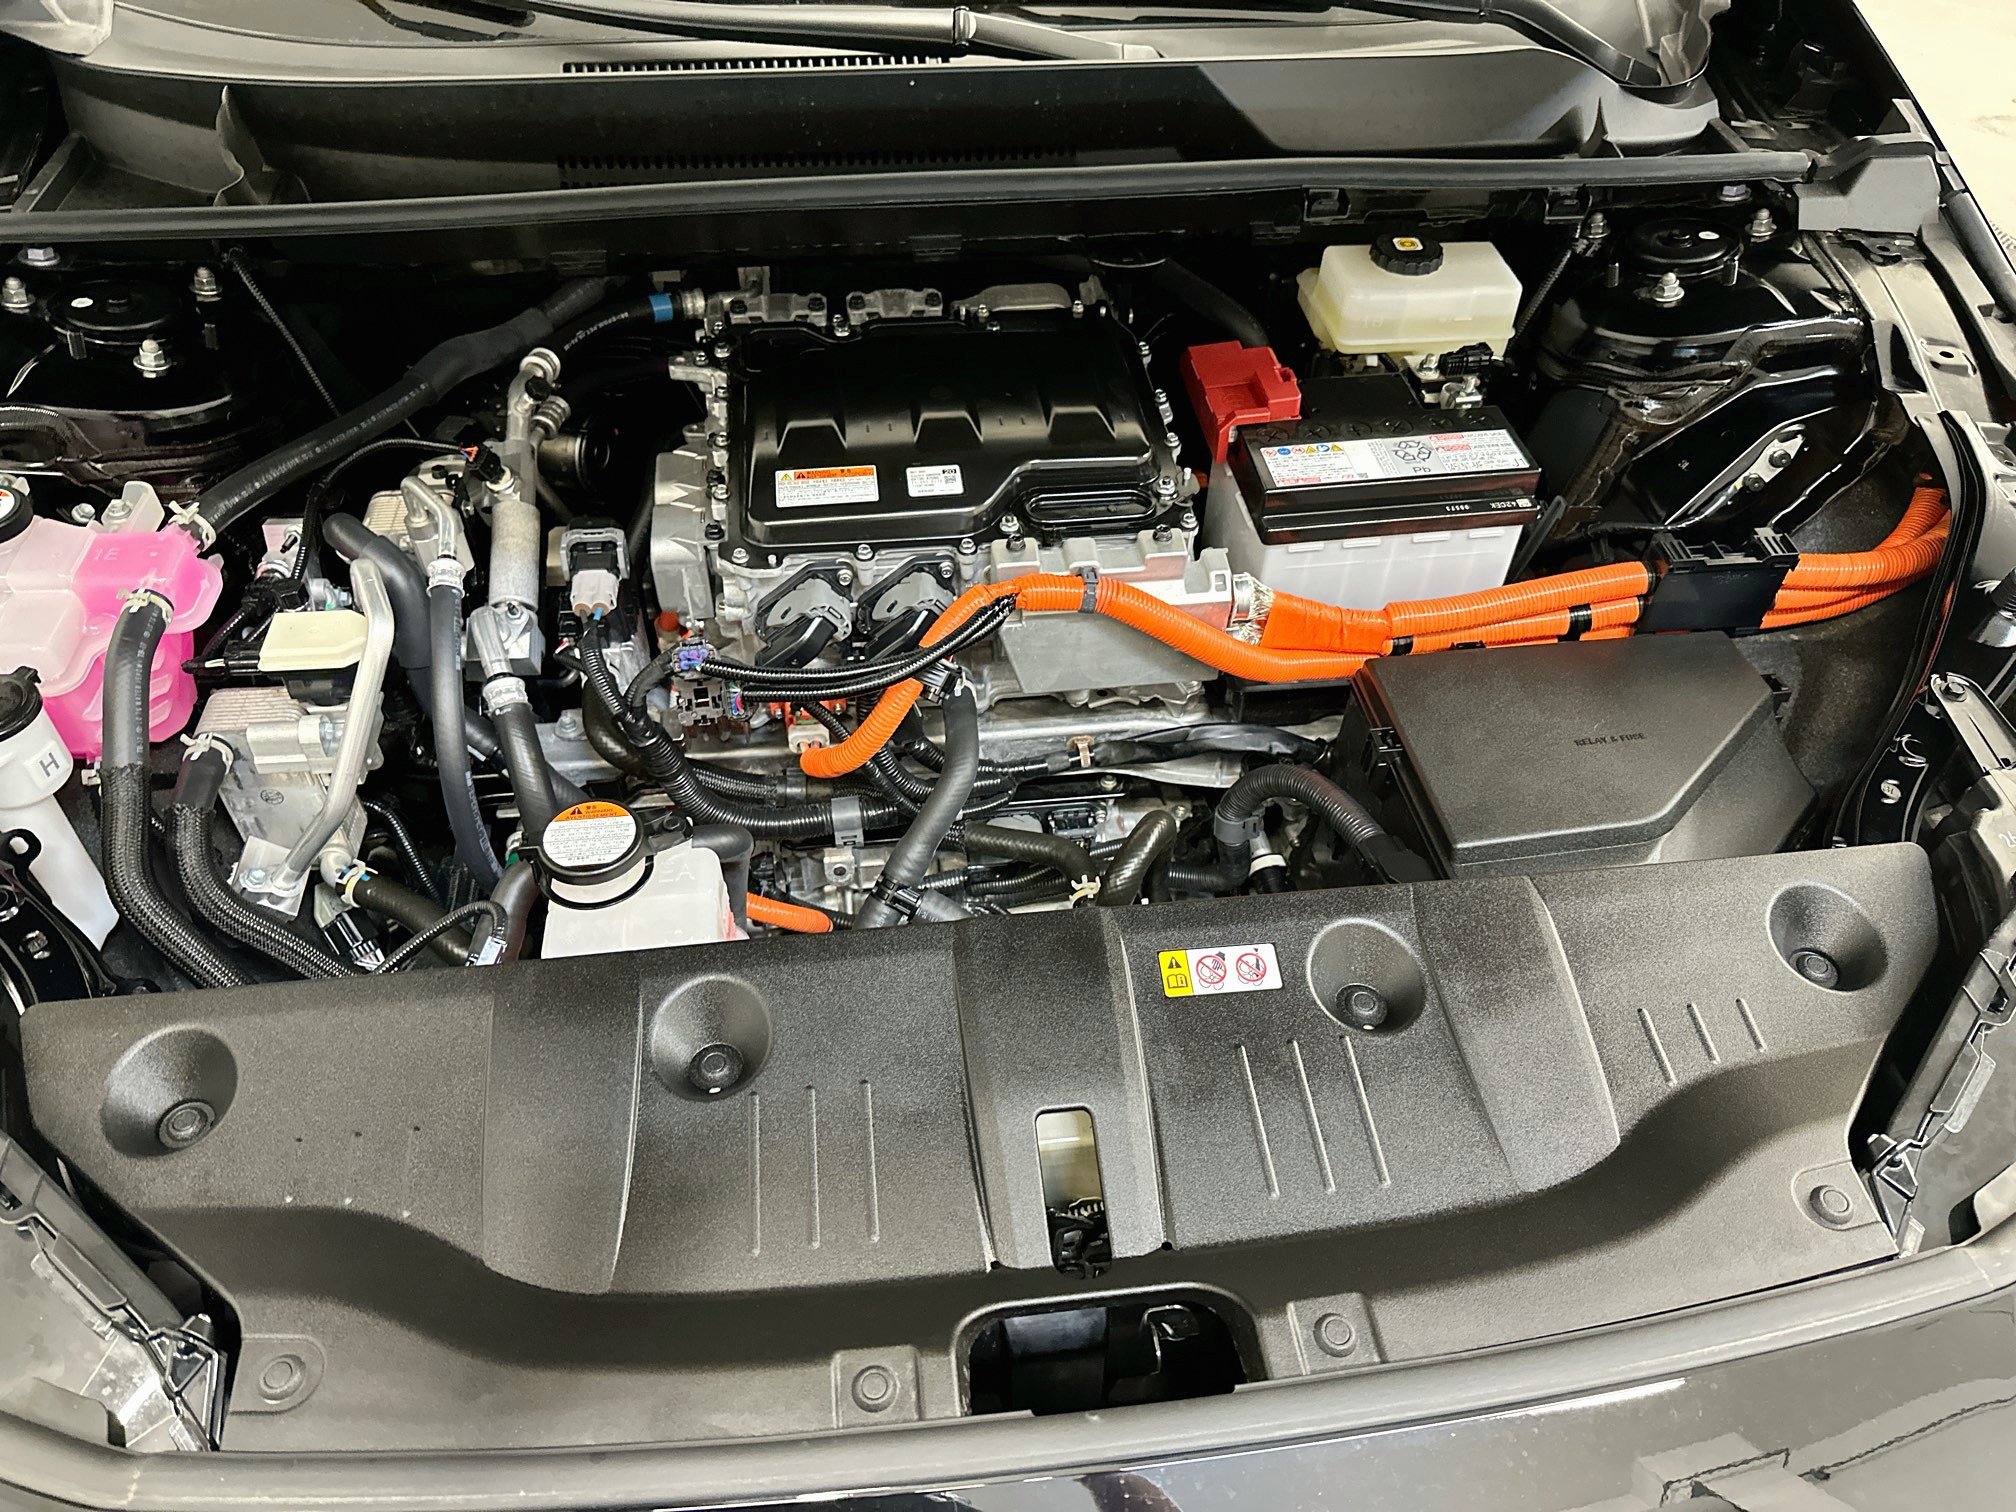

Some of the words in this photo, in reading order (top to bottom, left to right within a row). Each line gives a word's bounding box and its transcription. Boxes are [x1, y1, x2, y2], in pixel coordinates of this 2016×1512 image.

[1412, 466, 1432, 474] Pb
[1574, 736, 1607, 747] RELAY
[1619, 732, 1647, 742] FUSE
[39, 751, 60, 778] H
